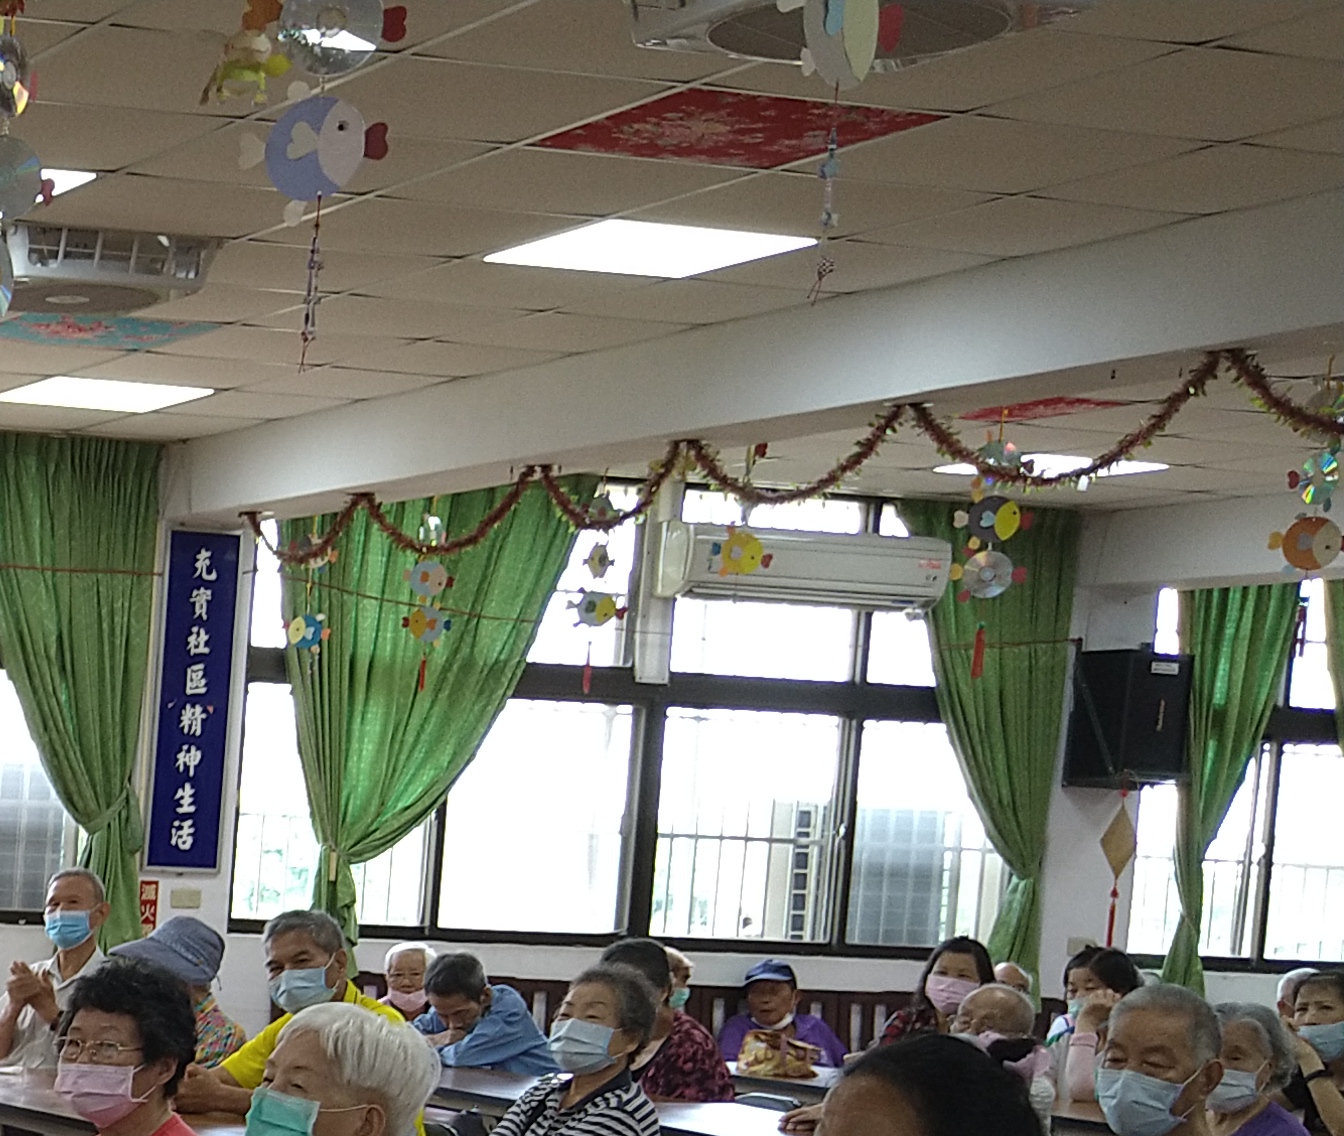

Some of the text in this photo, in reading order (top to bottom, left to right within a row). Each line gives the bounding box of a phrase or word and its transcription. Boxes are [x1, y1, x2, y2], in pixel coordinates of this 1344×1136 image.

[170, 547, 218, 851] 充實社區精神生活
